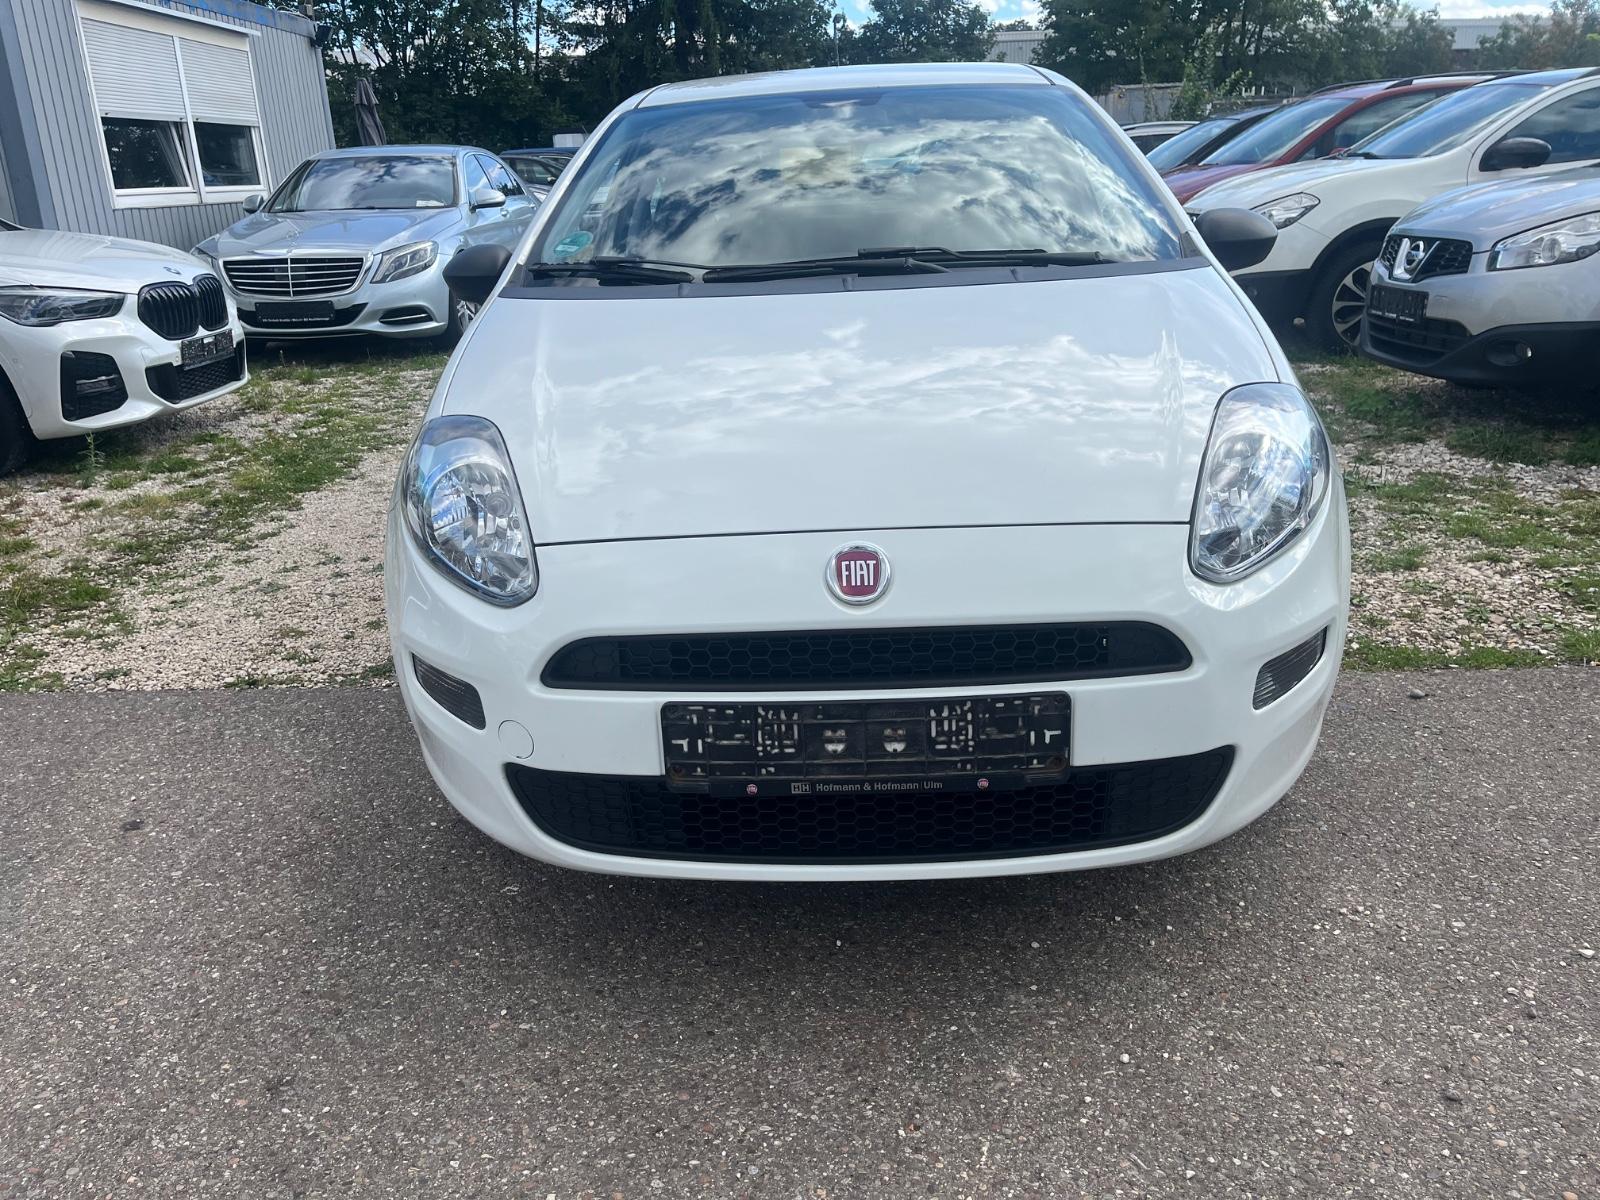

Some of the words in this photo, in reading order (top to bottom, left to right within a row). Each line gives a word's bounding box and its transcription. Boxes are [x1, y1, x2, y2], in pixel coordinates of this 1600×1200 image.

[841, 560, 877, 587] FIAT
[816, 783, 861, 792] Hofmann
[863, 782, 872, 791] &
[874, 782, 919, 791] Hofmann
[923, 780, 943, 789] Ulm
